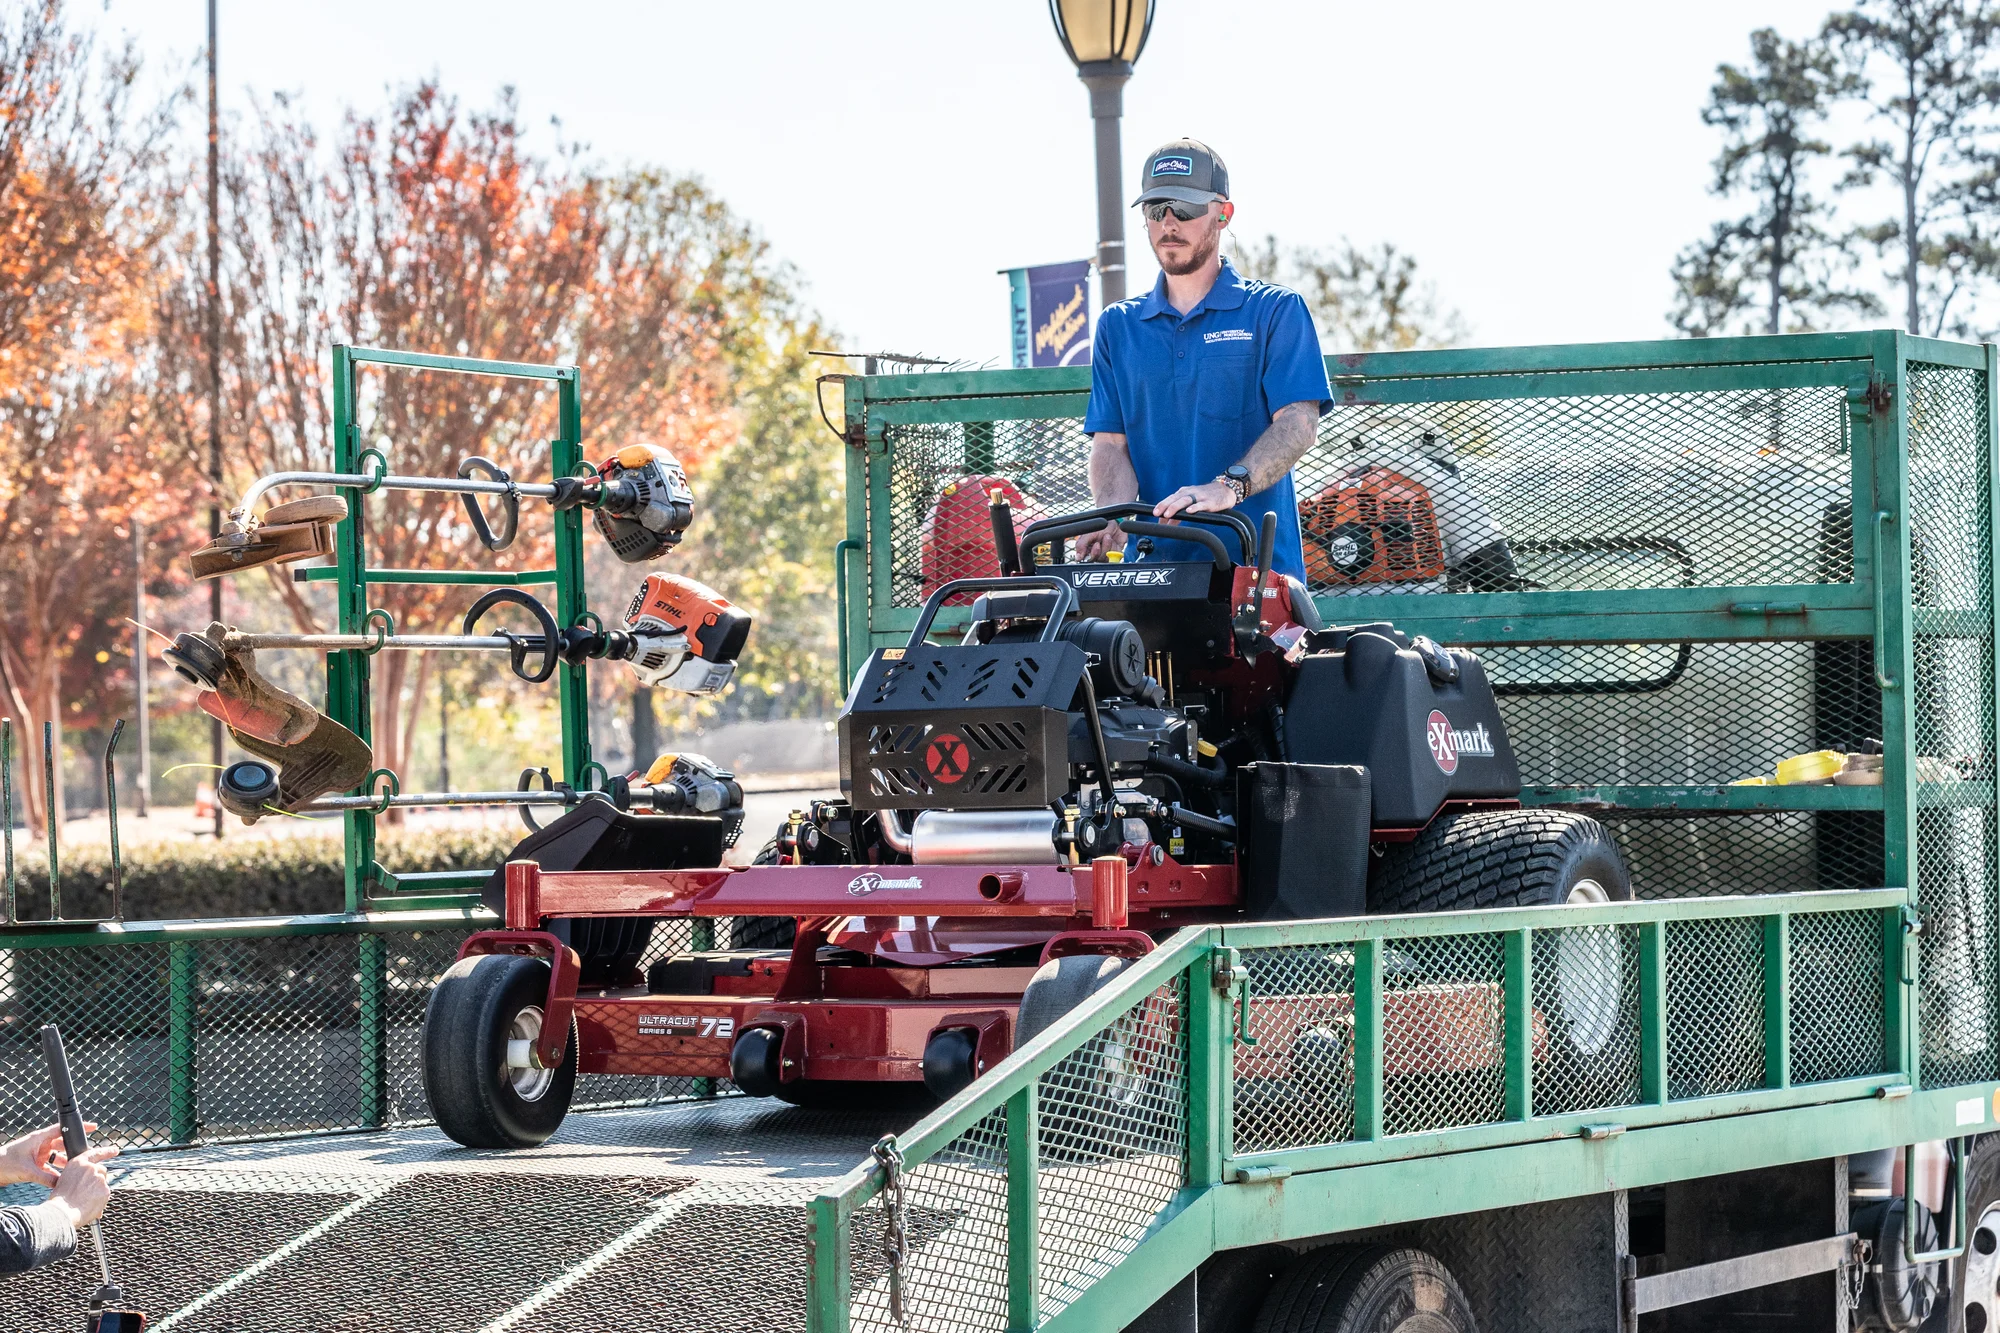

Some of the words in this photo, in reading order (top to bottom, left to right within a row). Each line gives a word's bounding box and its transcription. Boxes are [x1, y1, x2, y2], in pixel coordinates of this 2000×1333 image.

[1203, 331, 1220, 341] UNG
[1073, 569, 1172, 588] VERTEX
[653, 600, 682, 619] STIHL
[638, 1014, 699, 1027] ULTRACUT
[699, 1016, 734, 1038] 72
